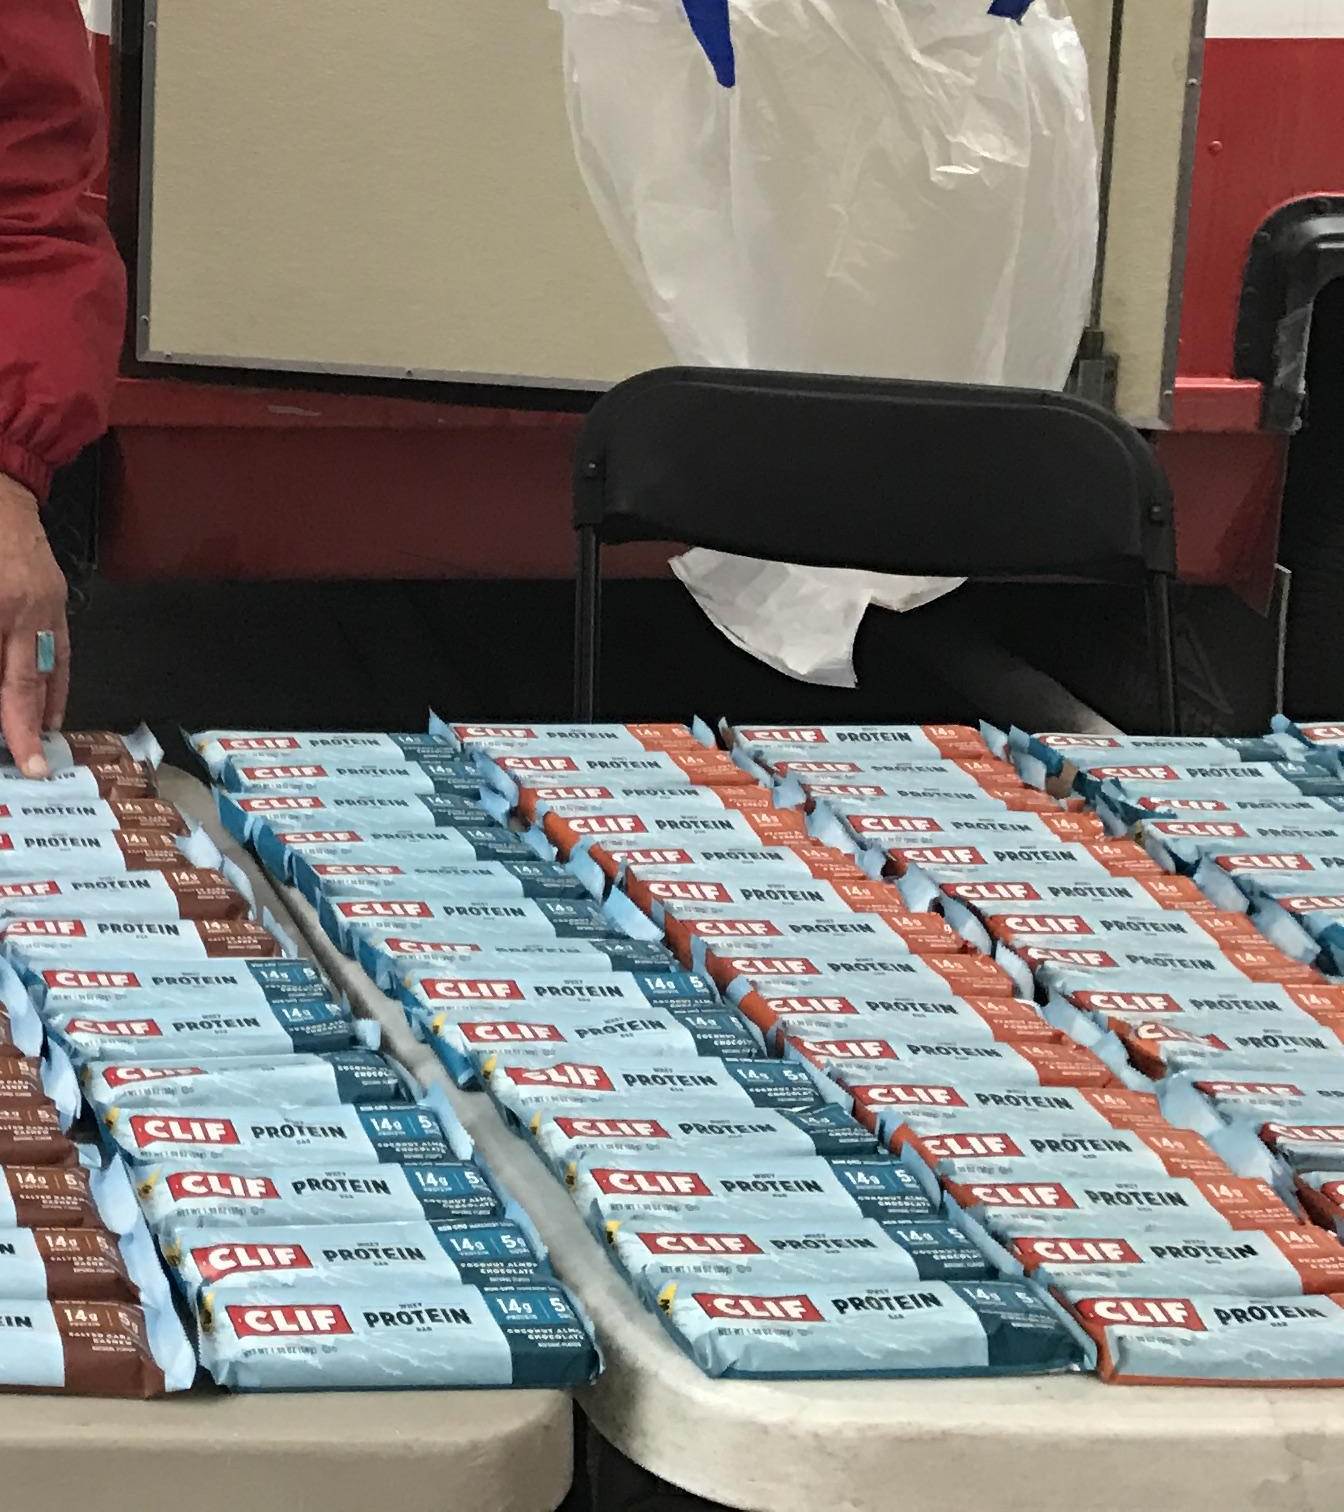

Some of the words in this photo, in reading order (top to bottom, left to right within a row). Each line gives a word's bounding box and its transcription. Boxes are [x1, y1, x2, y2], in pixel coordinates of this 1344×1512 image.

[1103, 767, 1175, 779] CLIF
[1187, 768, 1262, 777] PROTEIN
[569, 817, 643, 832] CLIF
[656, 820, 733, 829] PROTEIN
[25, 838, 100, 846] PROTEIN
[906, 848, 982, 863] CLIF
[994, 851, 1076, 861] PROTEIN
[350, 902, 424, 916] CLIF
[444, 907, 525, 916] PROTEIN
[1005, 917, 1089, 932] CLIF
[1100, 921, 1186, 933] PROTEIN
[56, 972, 134, 987] CLIF
[434, 981, 513, 998] CLIF
[535, 987, 623, 996] PROTEIN
[770, 997, 854, 1013] CLIF
[866, 1002, 957, 1014] PROTEIN
[868, 1088, 960, 1104] CLIF
[976, 1094, 1073, 1109] PROTEIN
[143, 1120, 228, 1142] CLIF
[251, 1125, 345, 1138] PROTEIN
[370, 1117, 403, 1134] 14g
[180, 1175, 268, 1198] CLIF
[292, 1179, 390, 1194] PROTEIN
[415, 1171, 449, 1188] 14g
[608, 1171, 698, 1193] CLIF
[721, 1181, 823, 1192] PROTEIN
[975, 1186, 1068, 1206] CLIF
[1085, 1191, 1187, 1206] PROTEIN
[450, 1237, 486, 1253] 14g
[655, 1235, 746, 1253] CLIF
[770, 1239, 875, 1249] PROTEIN
[1035, 1241, 1132, 1261] CLIF
[1150, 1245, 1258, 1259] PROTEIN
[208, 1246, 299, 1271] CLIF
[323, 1248, 425, 1261] PROTEIN
[496, 1298, 533, 1314] 14g
[712, 1296, 808, 1319] CLIF
[832, 1293, 942, 1314] PROTEIN
[64, 1309, 98, 1323] 14g
[240, 1309, 339, 1333] CLIF
[363, 1309, 471, 1327] PROTEIN
[1094, 1302, 1188, 1329] CLIF
[1214, 1306, 1326, 1325] PROTEIN
